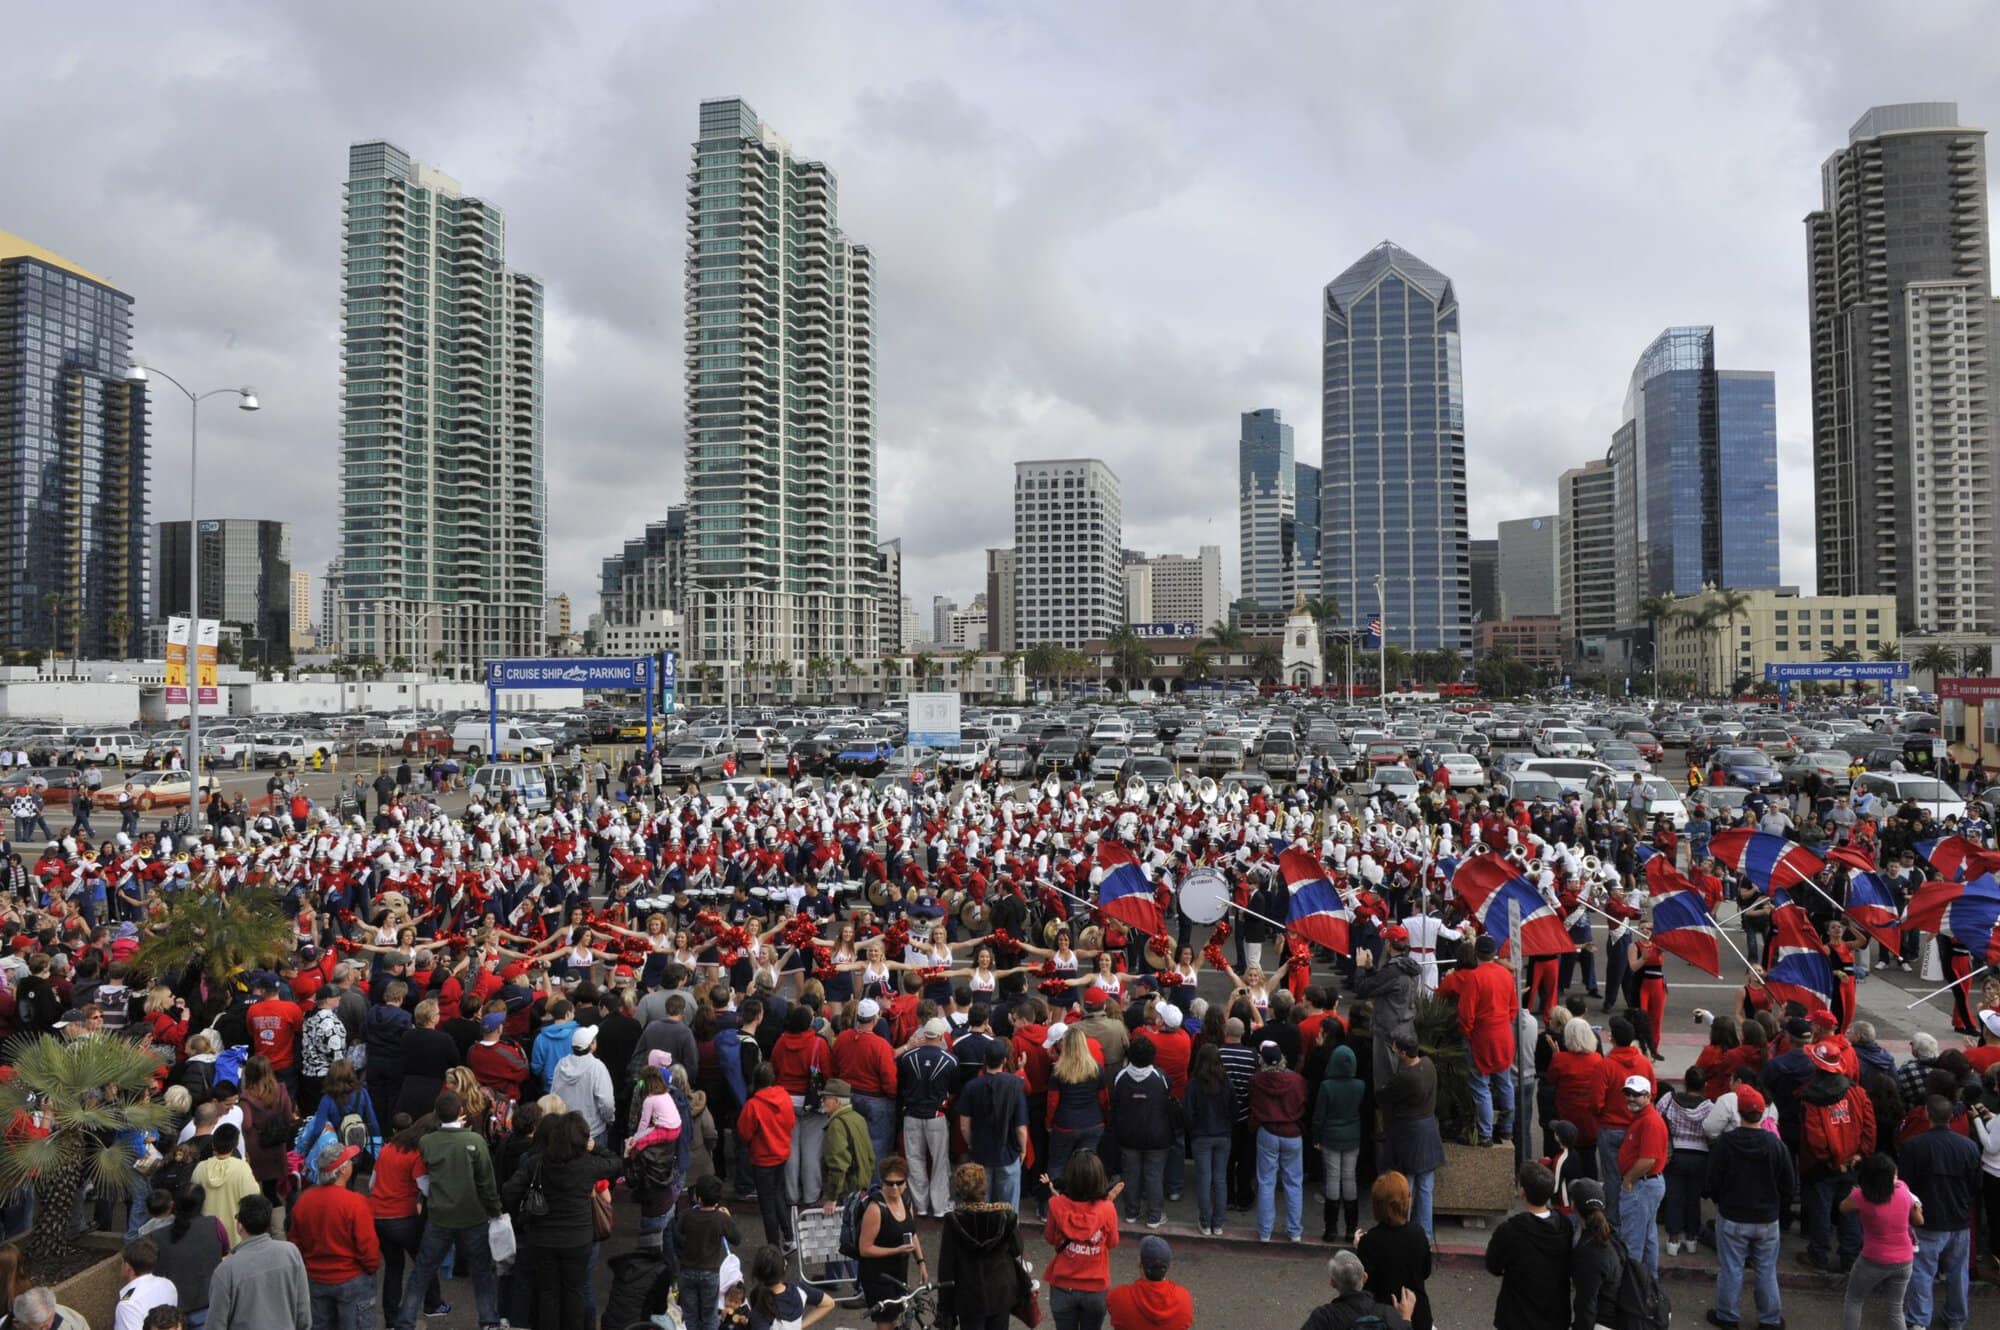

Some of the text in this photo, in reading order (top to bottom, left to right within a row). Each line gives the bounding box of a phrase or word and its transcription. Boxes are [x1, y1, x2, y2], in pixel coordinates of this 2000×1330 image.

[1114, 624, 1192, 635] Snta Fe
[493, 664, 502, 677] 5
[506, 668, 540, 680] CRUISE
[542, 668, 563, 680] SHIP
[589, 667, 631, 679] PARKING
[636, 663, 645, 675] 5
[665, 653, 674, 676] 5
[1780, 667, 1811, 676] CRUISE
[1813, 667, 1833, 675] SHIP
[1856, 667, 1893, 675] PARKING
